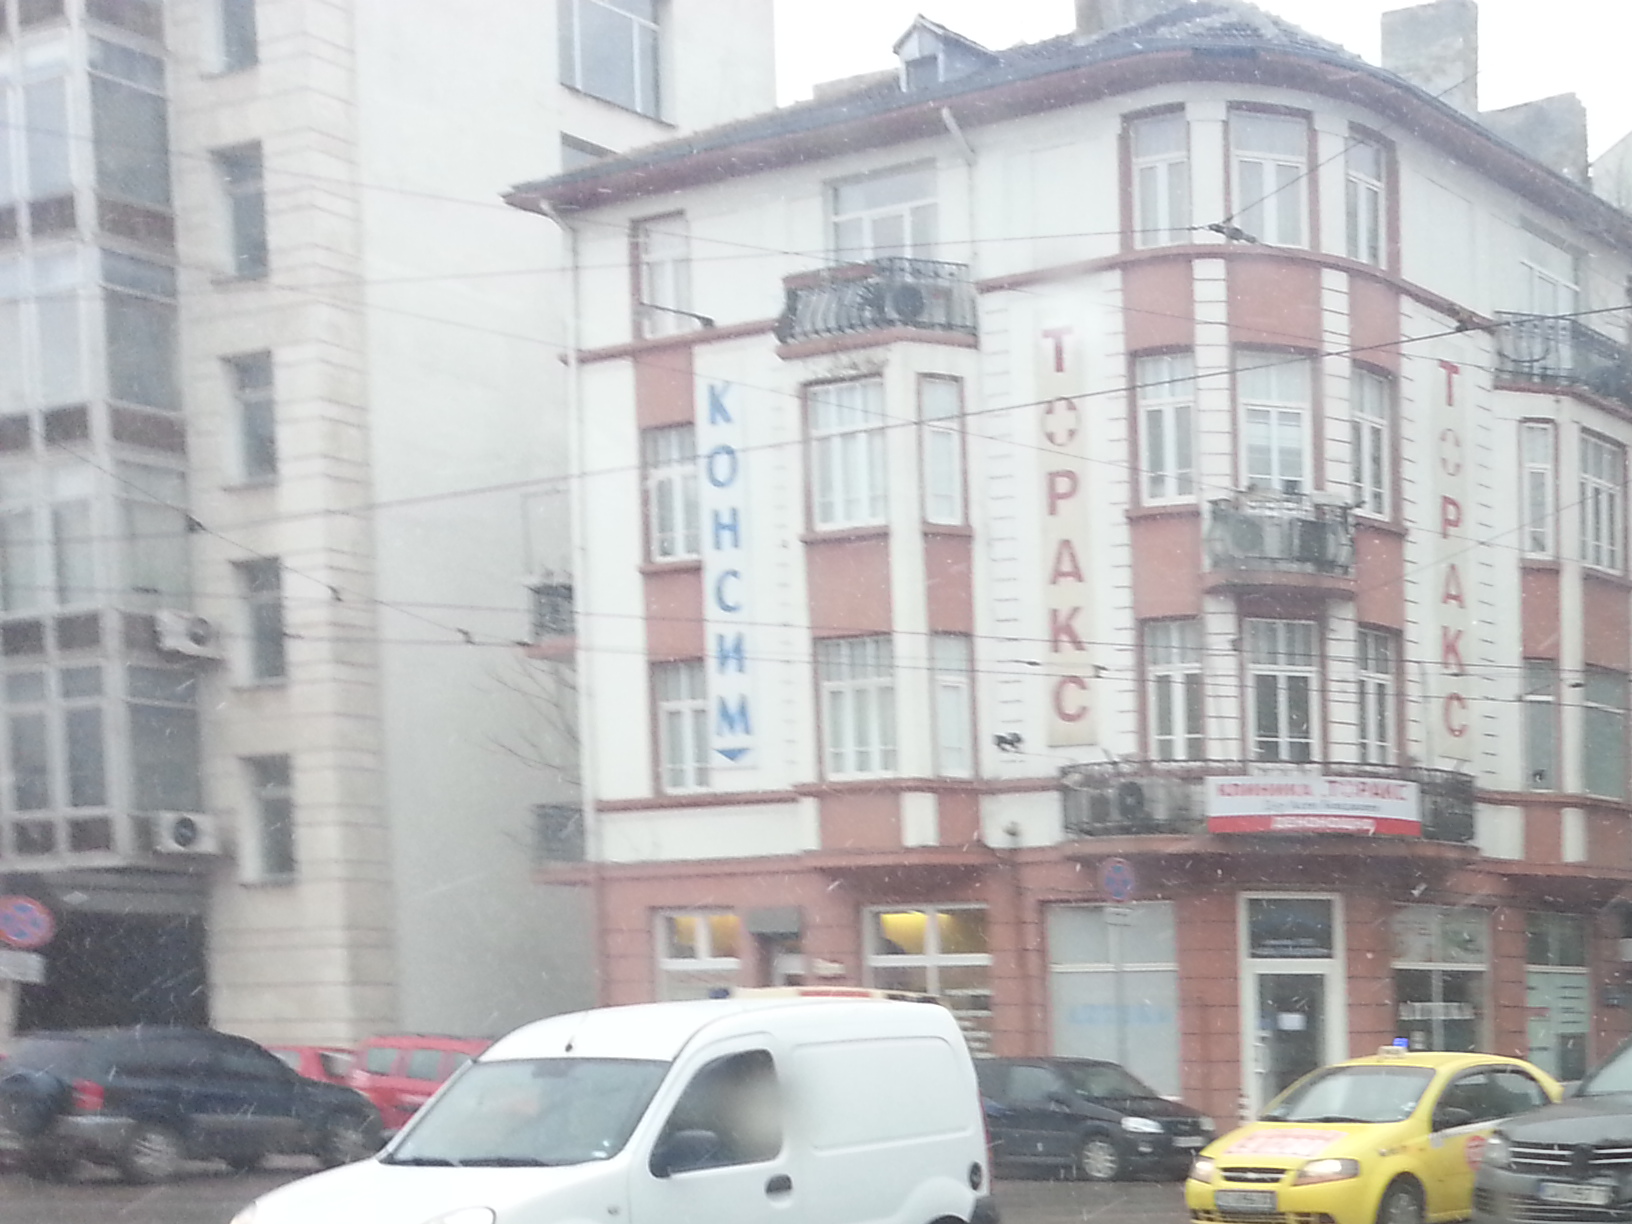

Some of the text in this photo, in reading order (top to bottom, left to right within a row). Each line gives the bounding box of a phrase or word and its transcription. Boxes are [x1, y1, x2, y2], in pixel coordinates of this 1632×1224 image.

[706, 380, 752, 737] КОНСИМ
[1041, 326, 1089, 723] ТОРАКС
[1438, 359, 1469, 738] ТОРАКС
